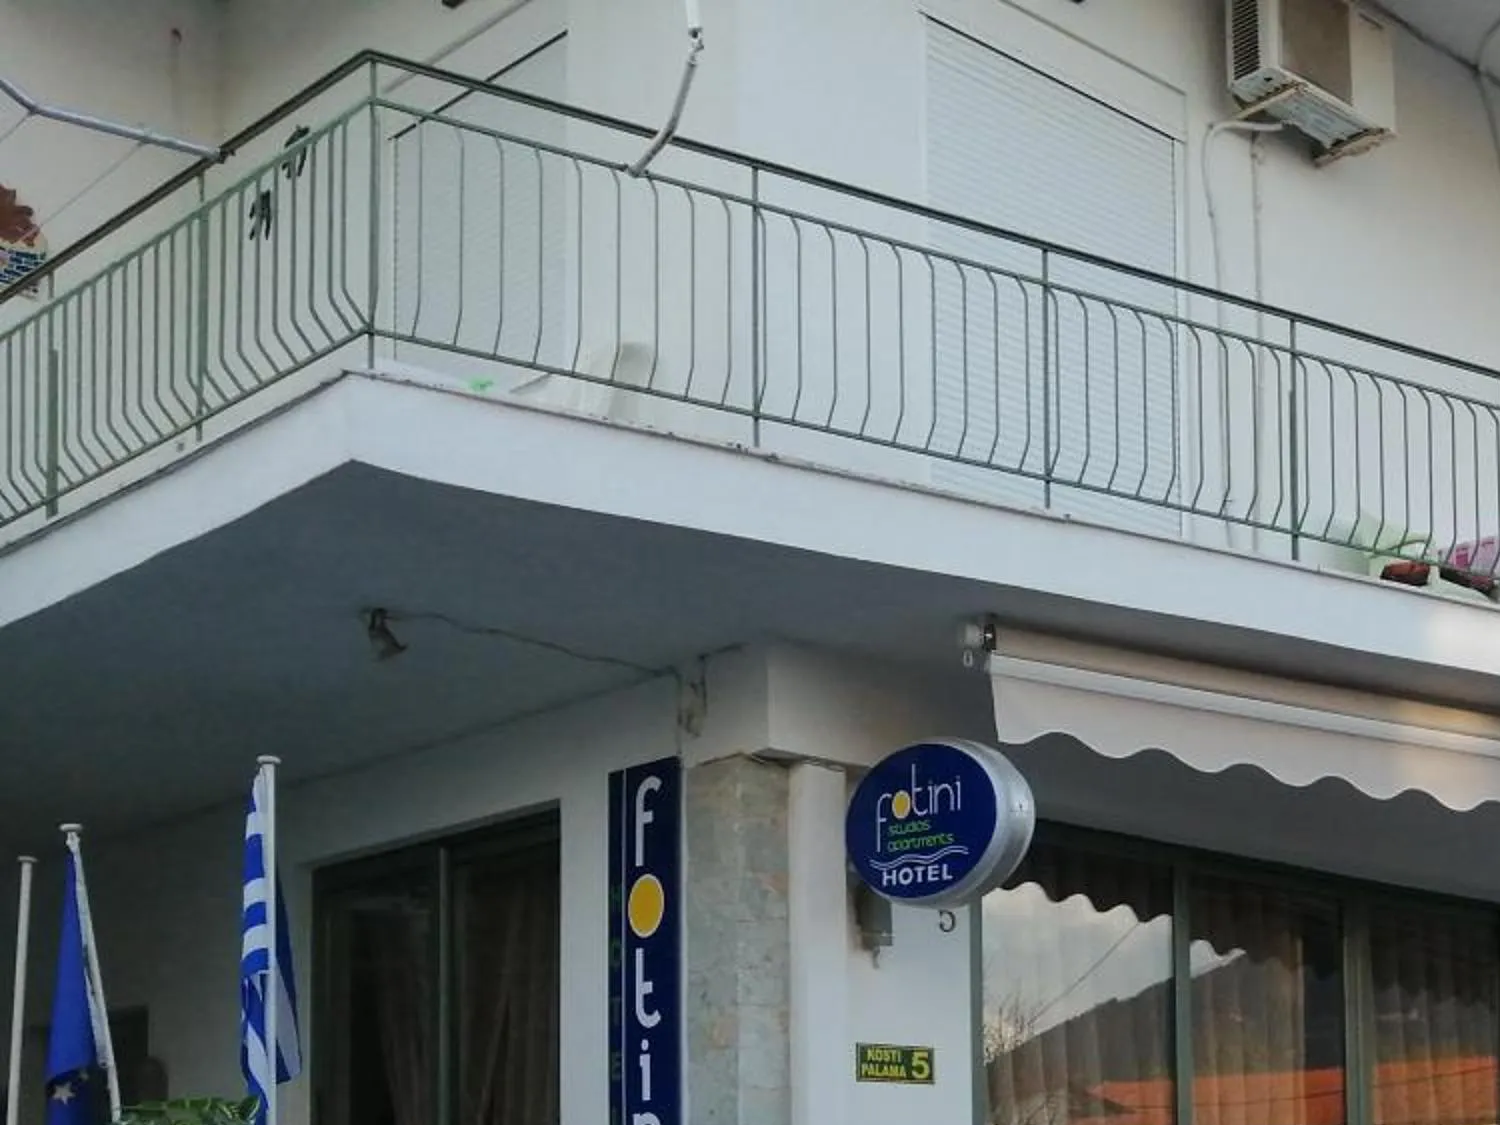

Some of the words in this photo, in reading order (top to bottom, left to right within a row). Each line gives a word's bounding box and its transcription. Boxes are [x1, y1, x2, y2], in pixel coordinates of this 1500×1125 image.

[876, 763, 961, 853] fotini
[881, 863, 953, 887] HOTEL
[911, 1049, 930, 1080] 5
